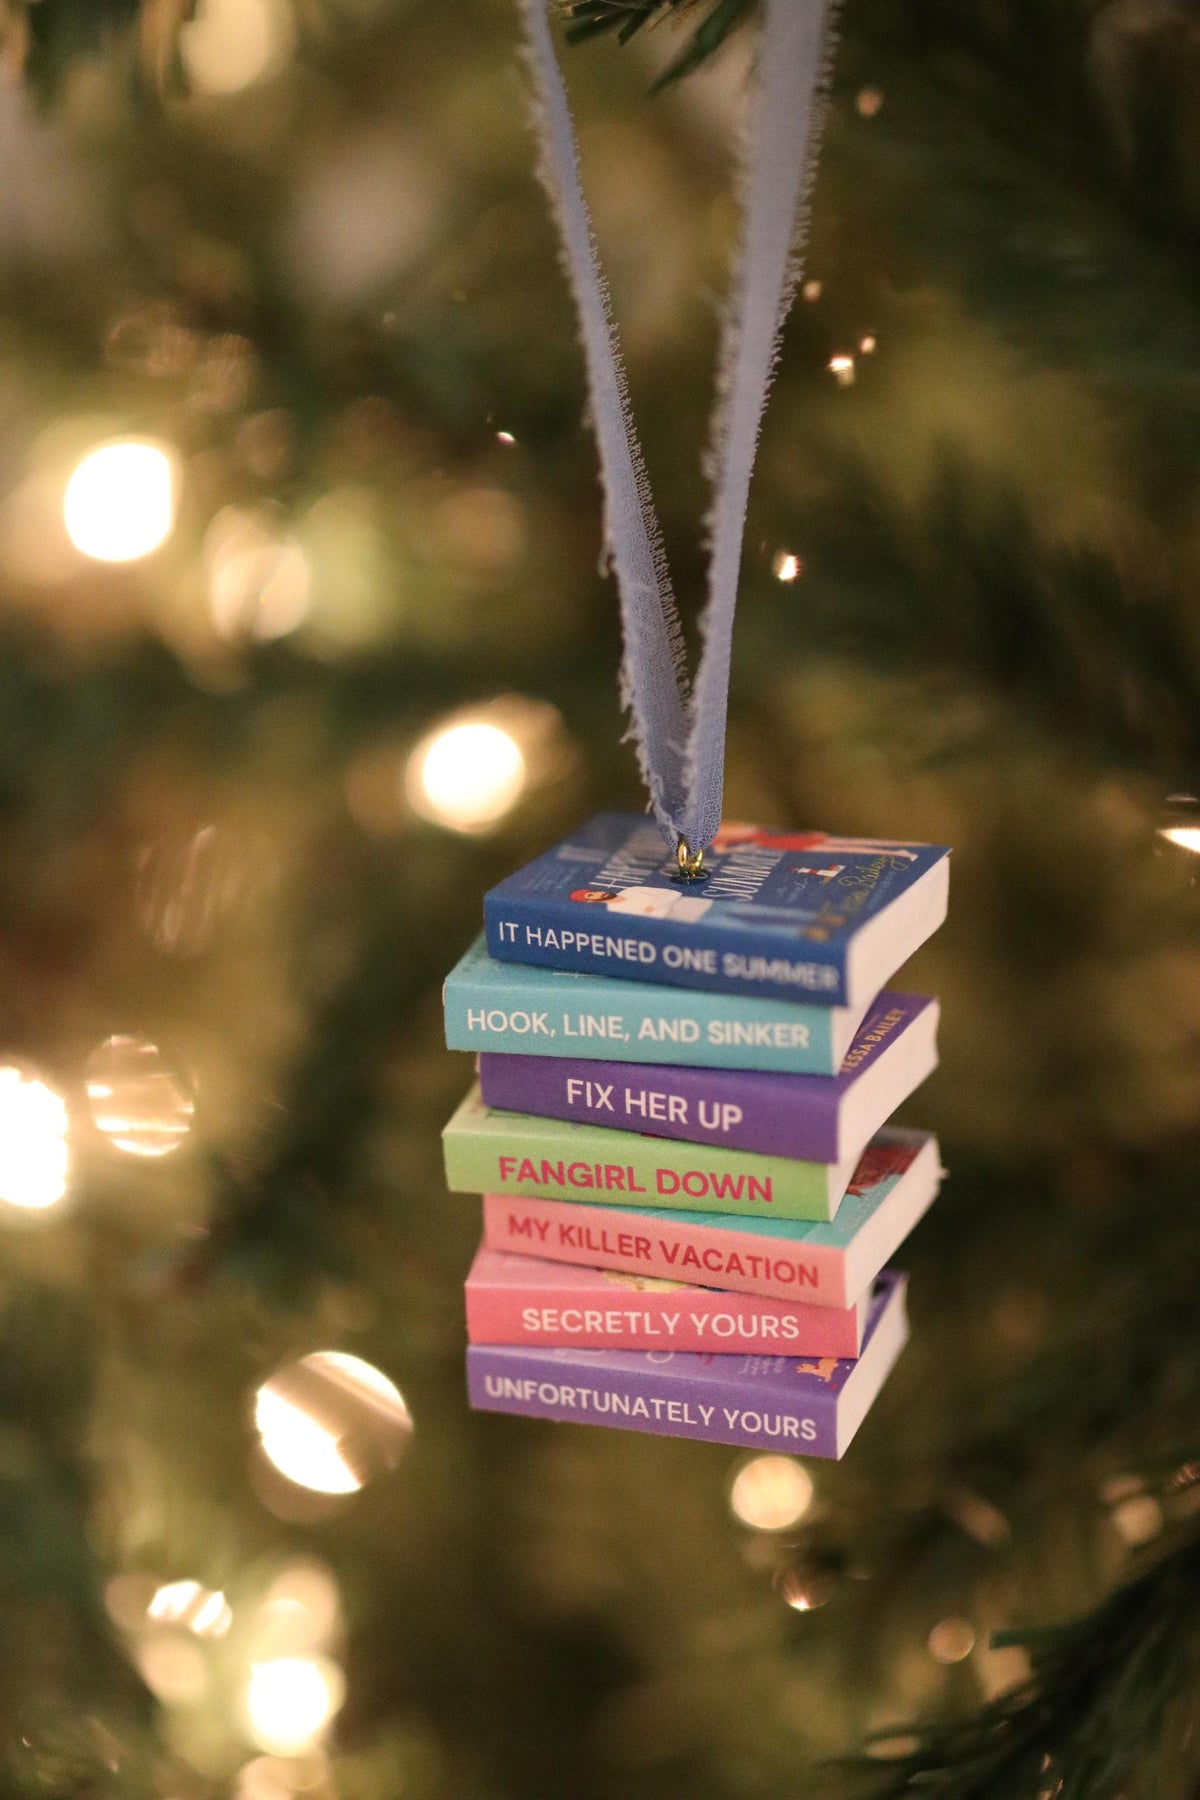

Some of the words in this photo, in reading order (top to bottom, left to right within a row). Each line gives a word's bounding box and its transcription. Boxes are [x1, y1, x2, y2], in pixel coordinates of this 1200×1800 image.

[498, 921, 519, 943] IT
[525, 925, 657, 964] HAPPENED
[662, 944, 718, 975] ONE
[722, 952, 840, 992] SUMMER
[467, 1008, 557, 1038] HOOK,
[563, 1013, 630, 1041] LINE,
[638, 1018, 699, 1043] AND
[707, 1020, 810, 1049] SINKER
[864, 1007, 907, 1042] BAILEY
[566, 1078, 616, 1112] FIX
[624, 1088, 689, 1125] HER
[697, 1101, 743, 1133] UP
[498, 1156, 647, 1193] FANGIRL
[655, 1168, 773, 1203] DOWN
[507, 1214, 550, 1241] MY
[559, 1222, 652, 1261] KILLER
[658, 1240, 819, 1288] VACATION
[521, 1307, 681, 1336] SECRETLY
[689, 1312, 800, 1339] YOURS
[485, 1374, 714, 1426] UNFORTUNATELY
[722, 1408, 818, 1441] YOURS
